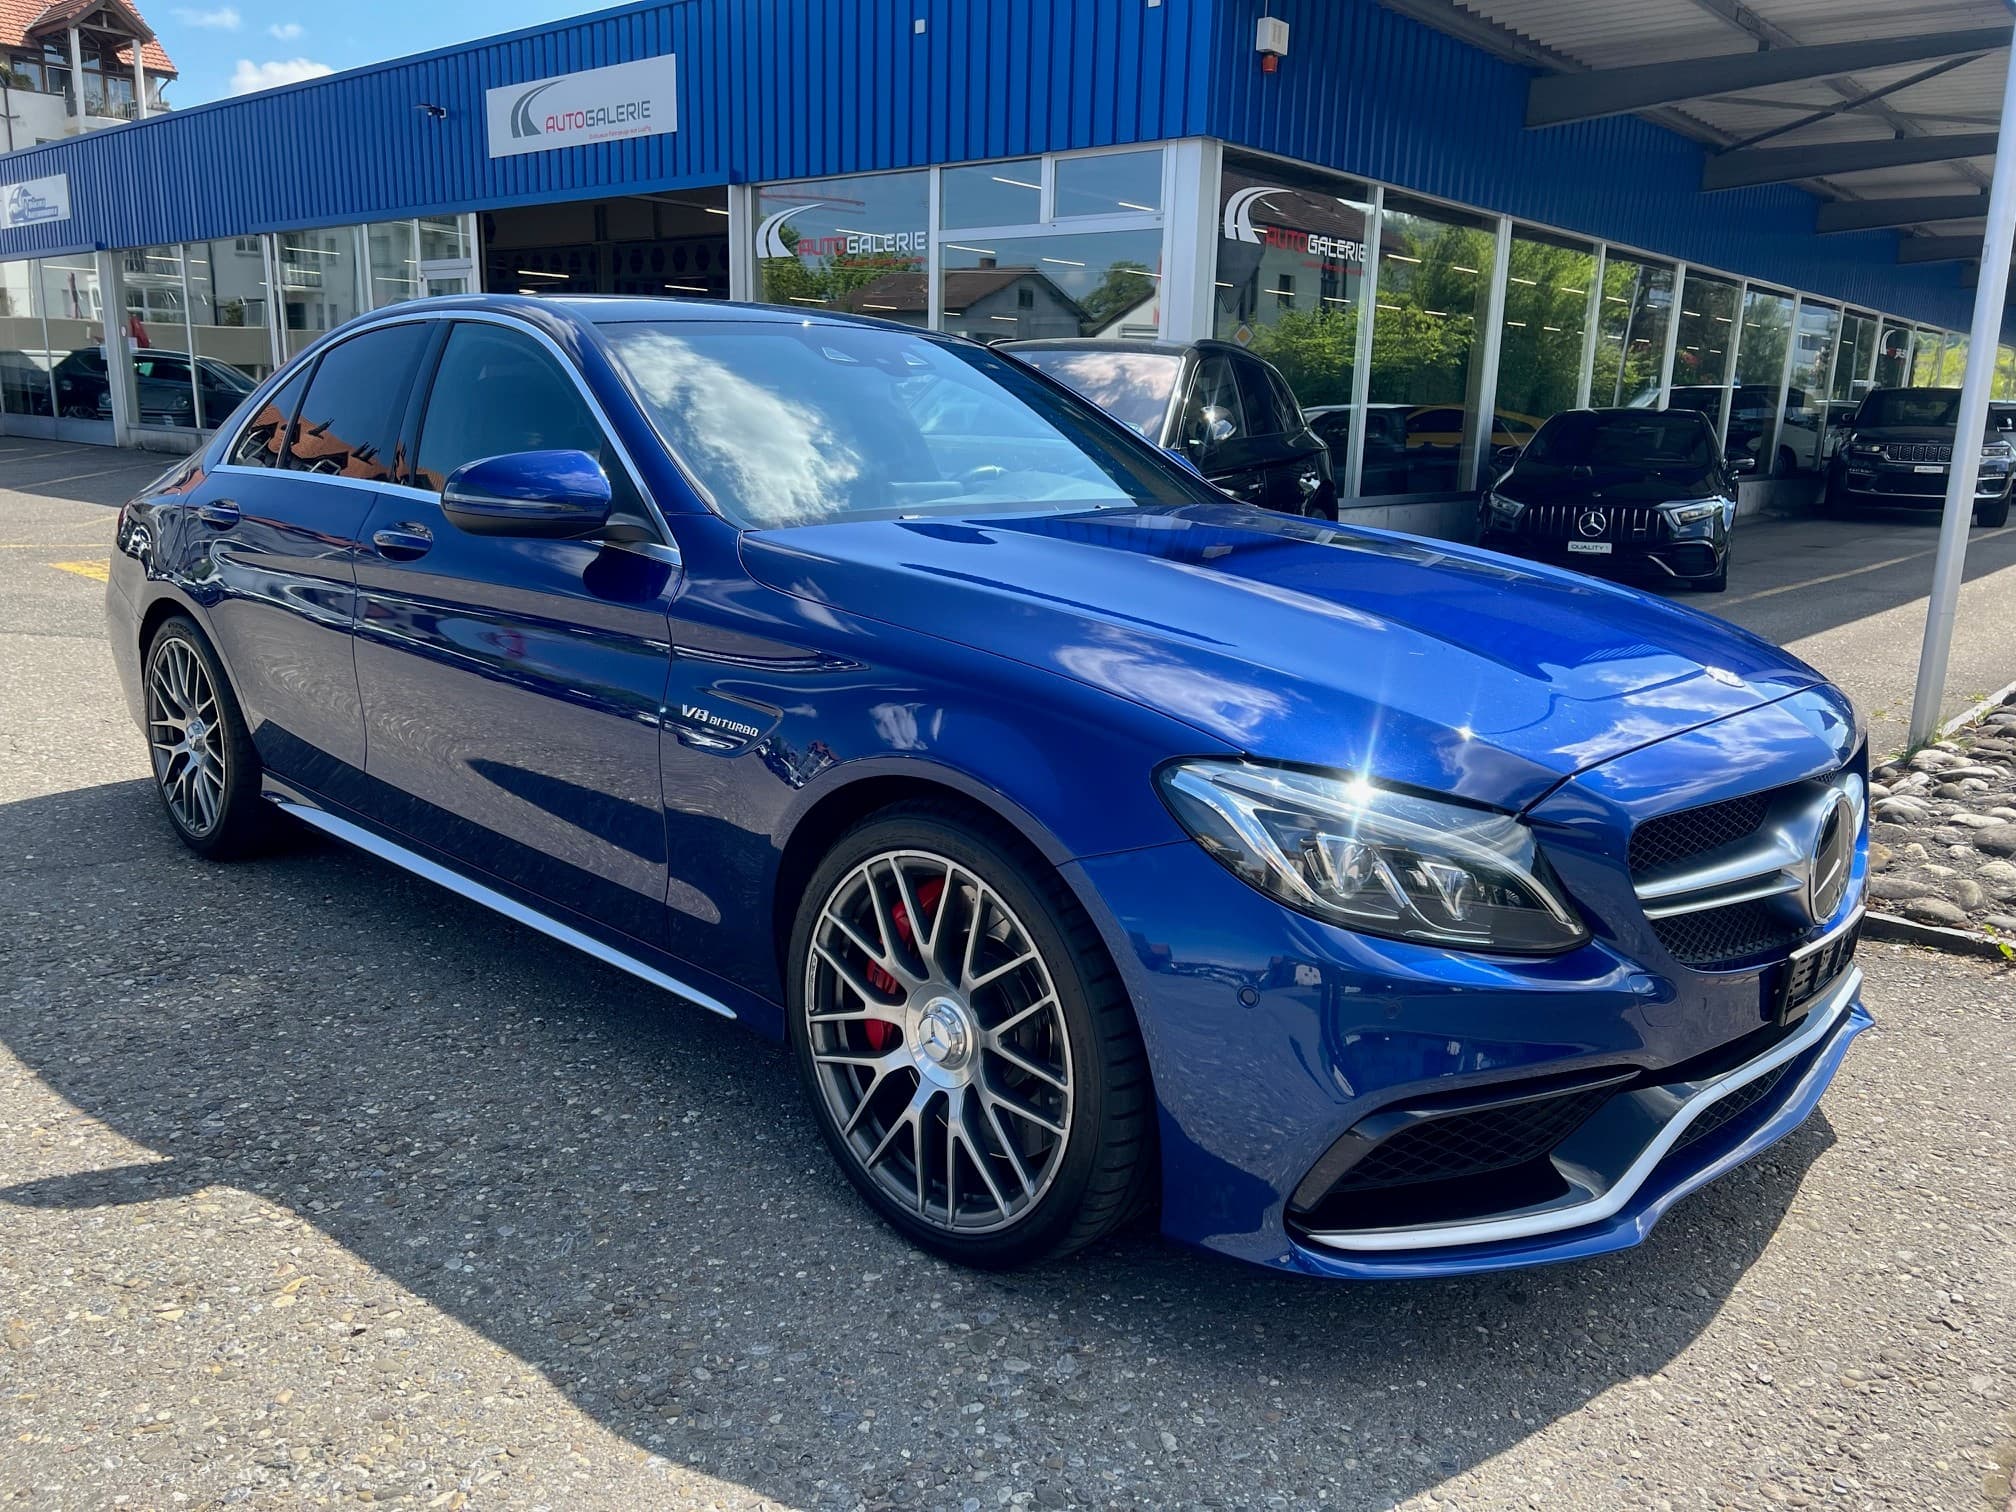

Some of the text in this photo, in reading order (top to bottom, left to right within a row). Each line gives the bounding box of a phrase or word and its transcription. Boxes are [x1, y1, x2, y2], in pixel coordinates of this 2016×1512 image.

[545, 100, 651, 134] AUTOGALERIE
[797, 231, 927, 256] AUTOGALERIE
[1265, 226, 1369, 263] AUTOGALERIE
[682, 703, 759, 738] V8 BITURBO
